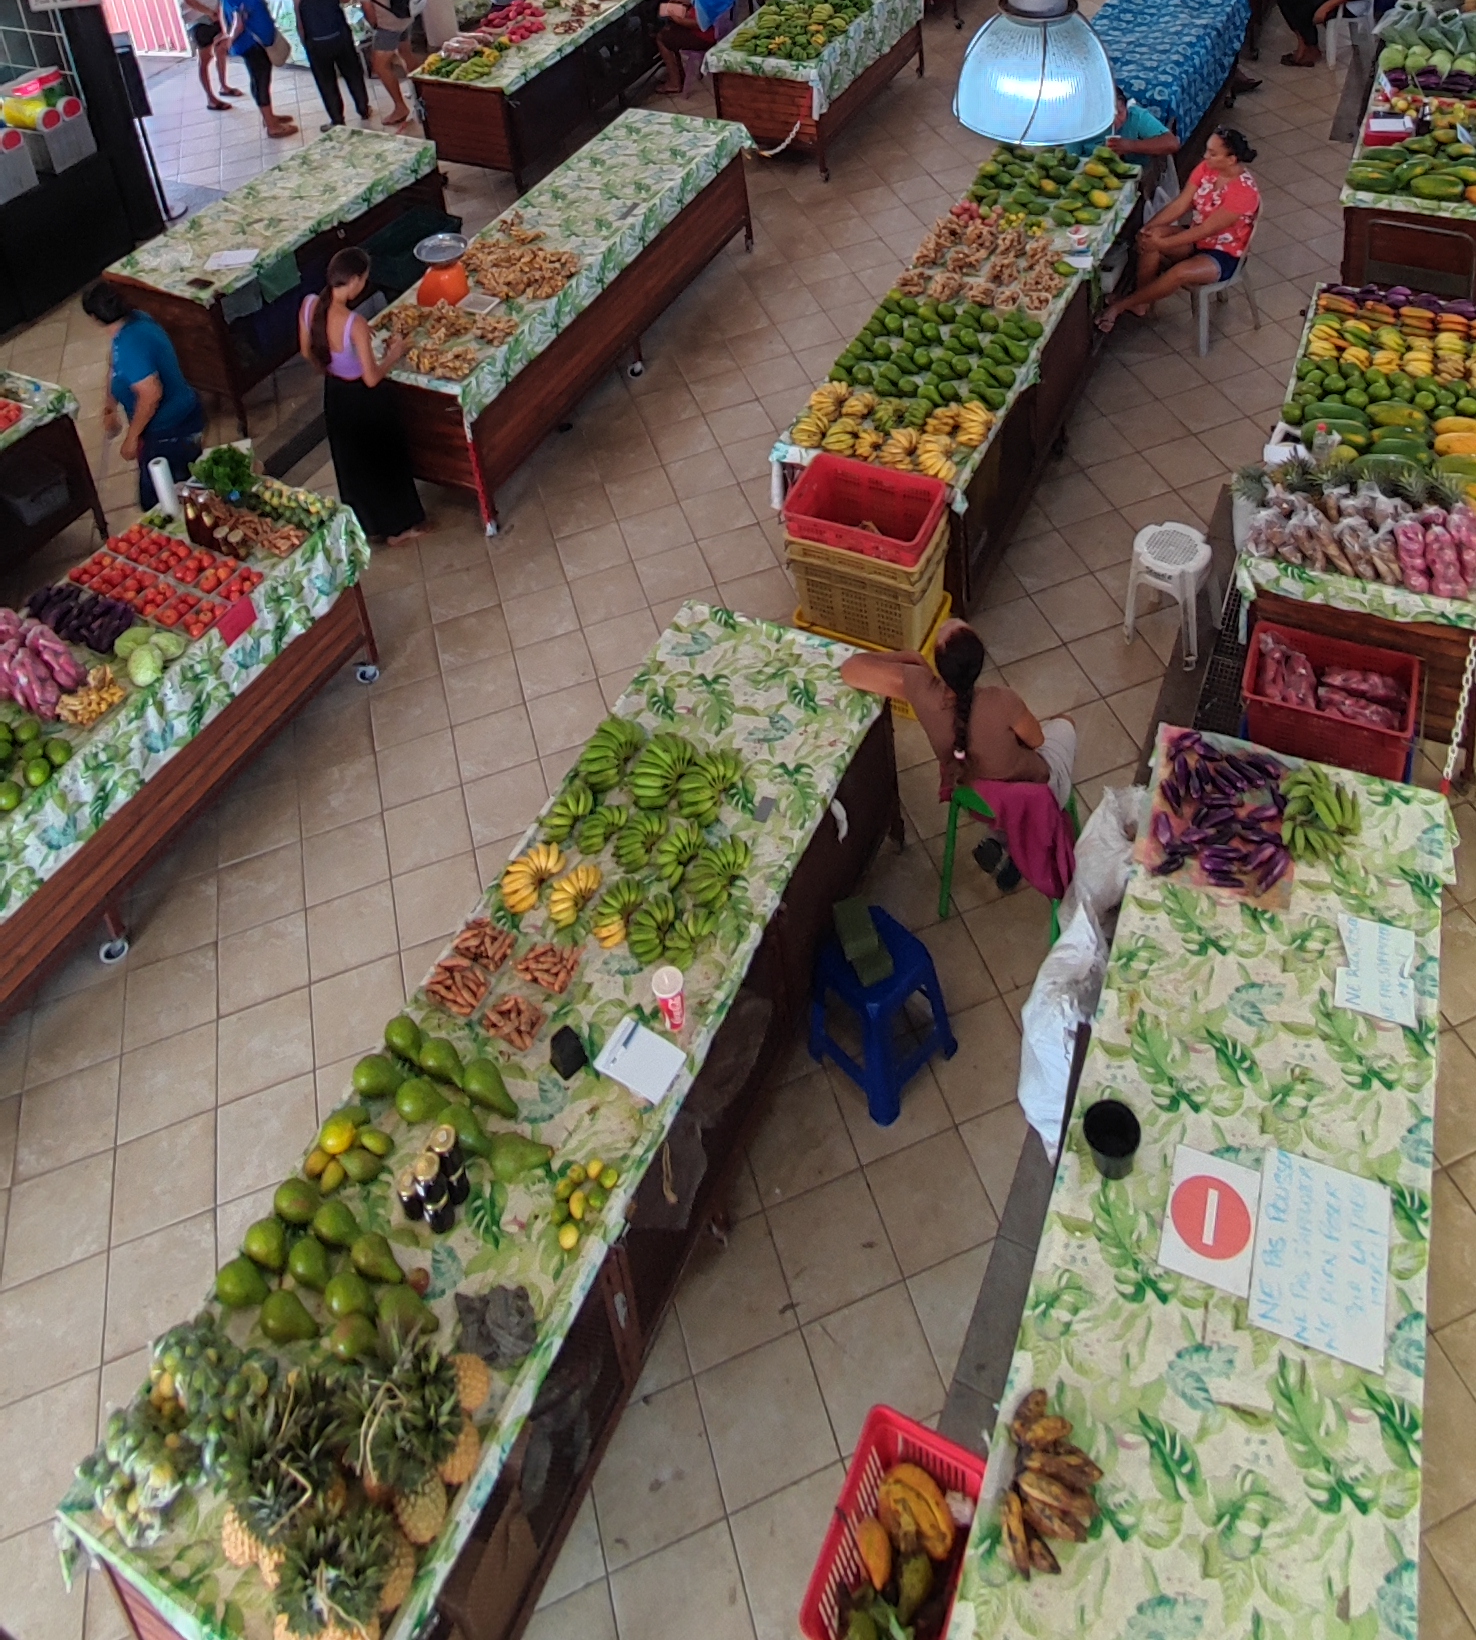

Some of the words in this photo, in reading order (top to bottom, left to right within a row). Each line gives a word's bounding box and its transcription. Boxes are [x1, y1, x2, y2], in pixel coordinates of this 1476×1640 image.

[1345, 983, 1361, 1006] NE
[1262, 1236, 1287, 1268] PAS
[1350, 1238, 1367, 1265] LA
[1257, 1278, 1282, 1324] NE
[1290, 1270, 1311, 1300] PAS
[1291, 1308, 1310, 1342] NE
[1315, 1314, 1340, 1351] NE
